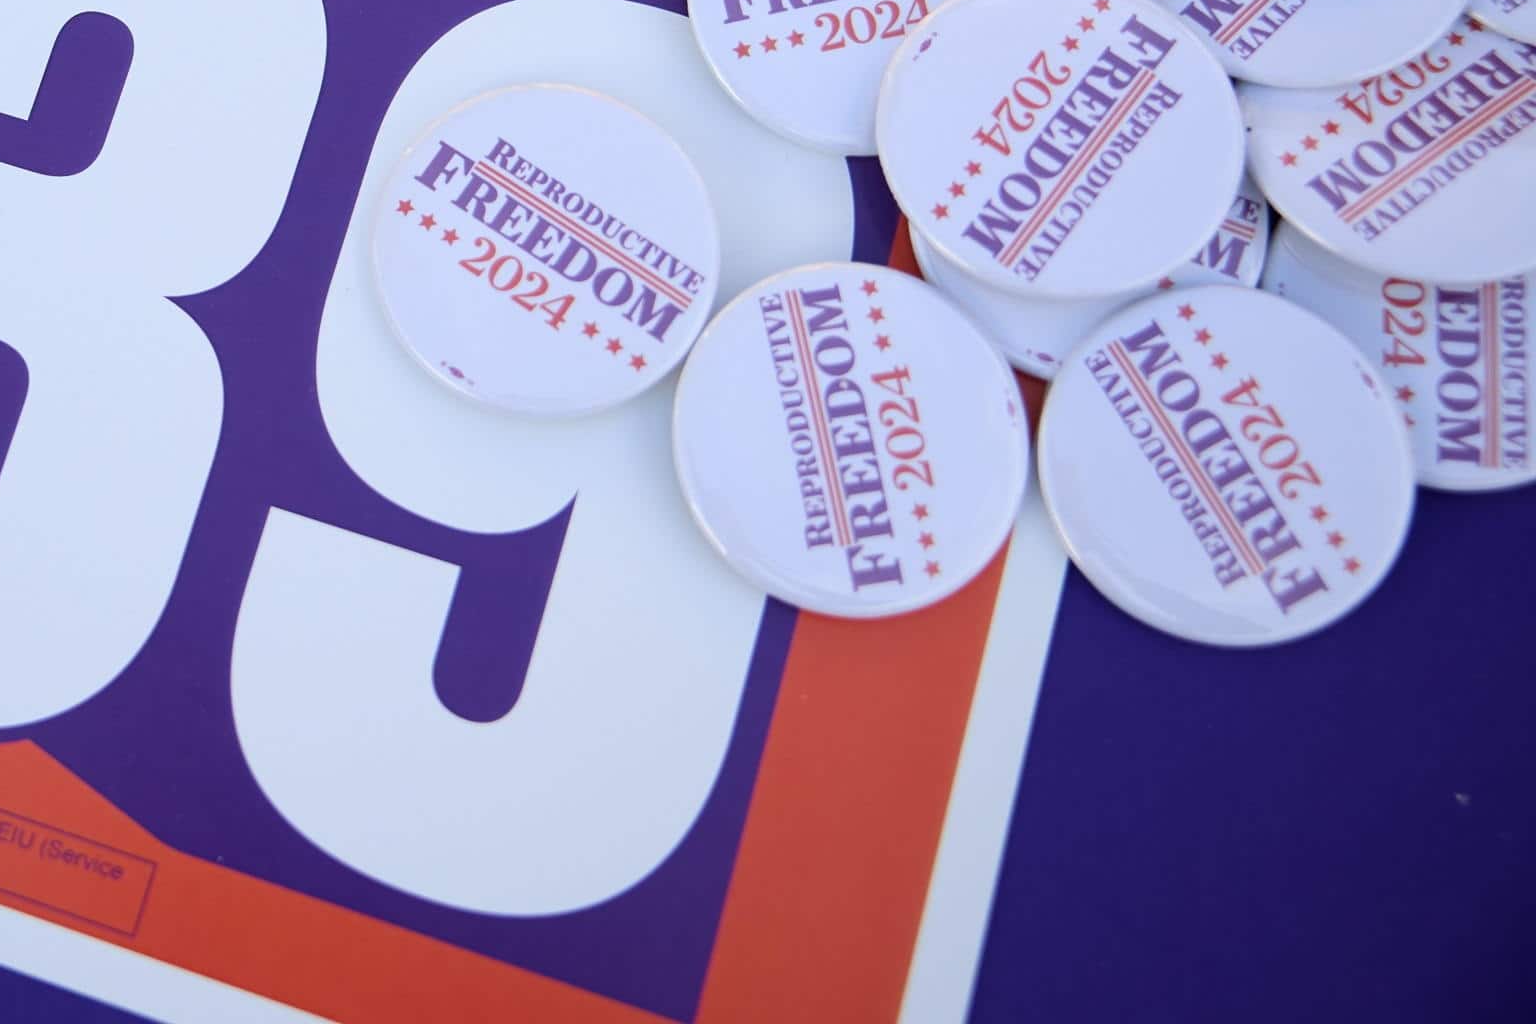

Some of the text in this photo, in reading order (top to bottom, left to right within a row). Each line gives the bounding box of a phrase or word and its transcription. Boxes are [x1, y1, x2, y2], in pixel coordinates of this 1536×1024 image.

[961, 14, 1177, 259] FREEDOM
[972, 50, 1071, 157] 2024
[1015, 80, 1183, 283] REPRODUCTIVE
[1352, 96, 1536, 242] EPRODUCTIVE
[413, 140, 685, 344] FREEDOM
[458, 236, 576, 331] 2024
[484, 136, 705, 295] REPRODUCTIVE
[1381, 277, 1426, 367] 024
[1435, 286, 1481, 465] EDOM
[1502, 274, 1528, 469] RODUCTIVE
[759, 292, 835, 550] REPRODUCTIVE
[799, 283, 904, 592] FREEDOM
[870, 364, 935, 491] 2024
[1084, 348, 1249, 590] REPRODUCTIVE
[1119, 318, 1330, 616] FREEDOM
[1220, 374, 1323, 499] 2024
[39, 837, 125, 881] (Service
